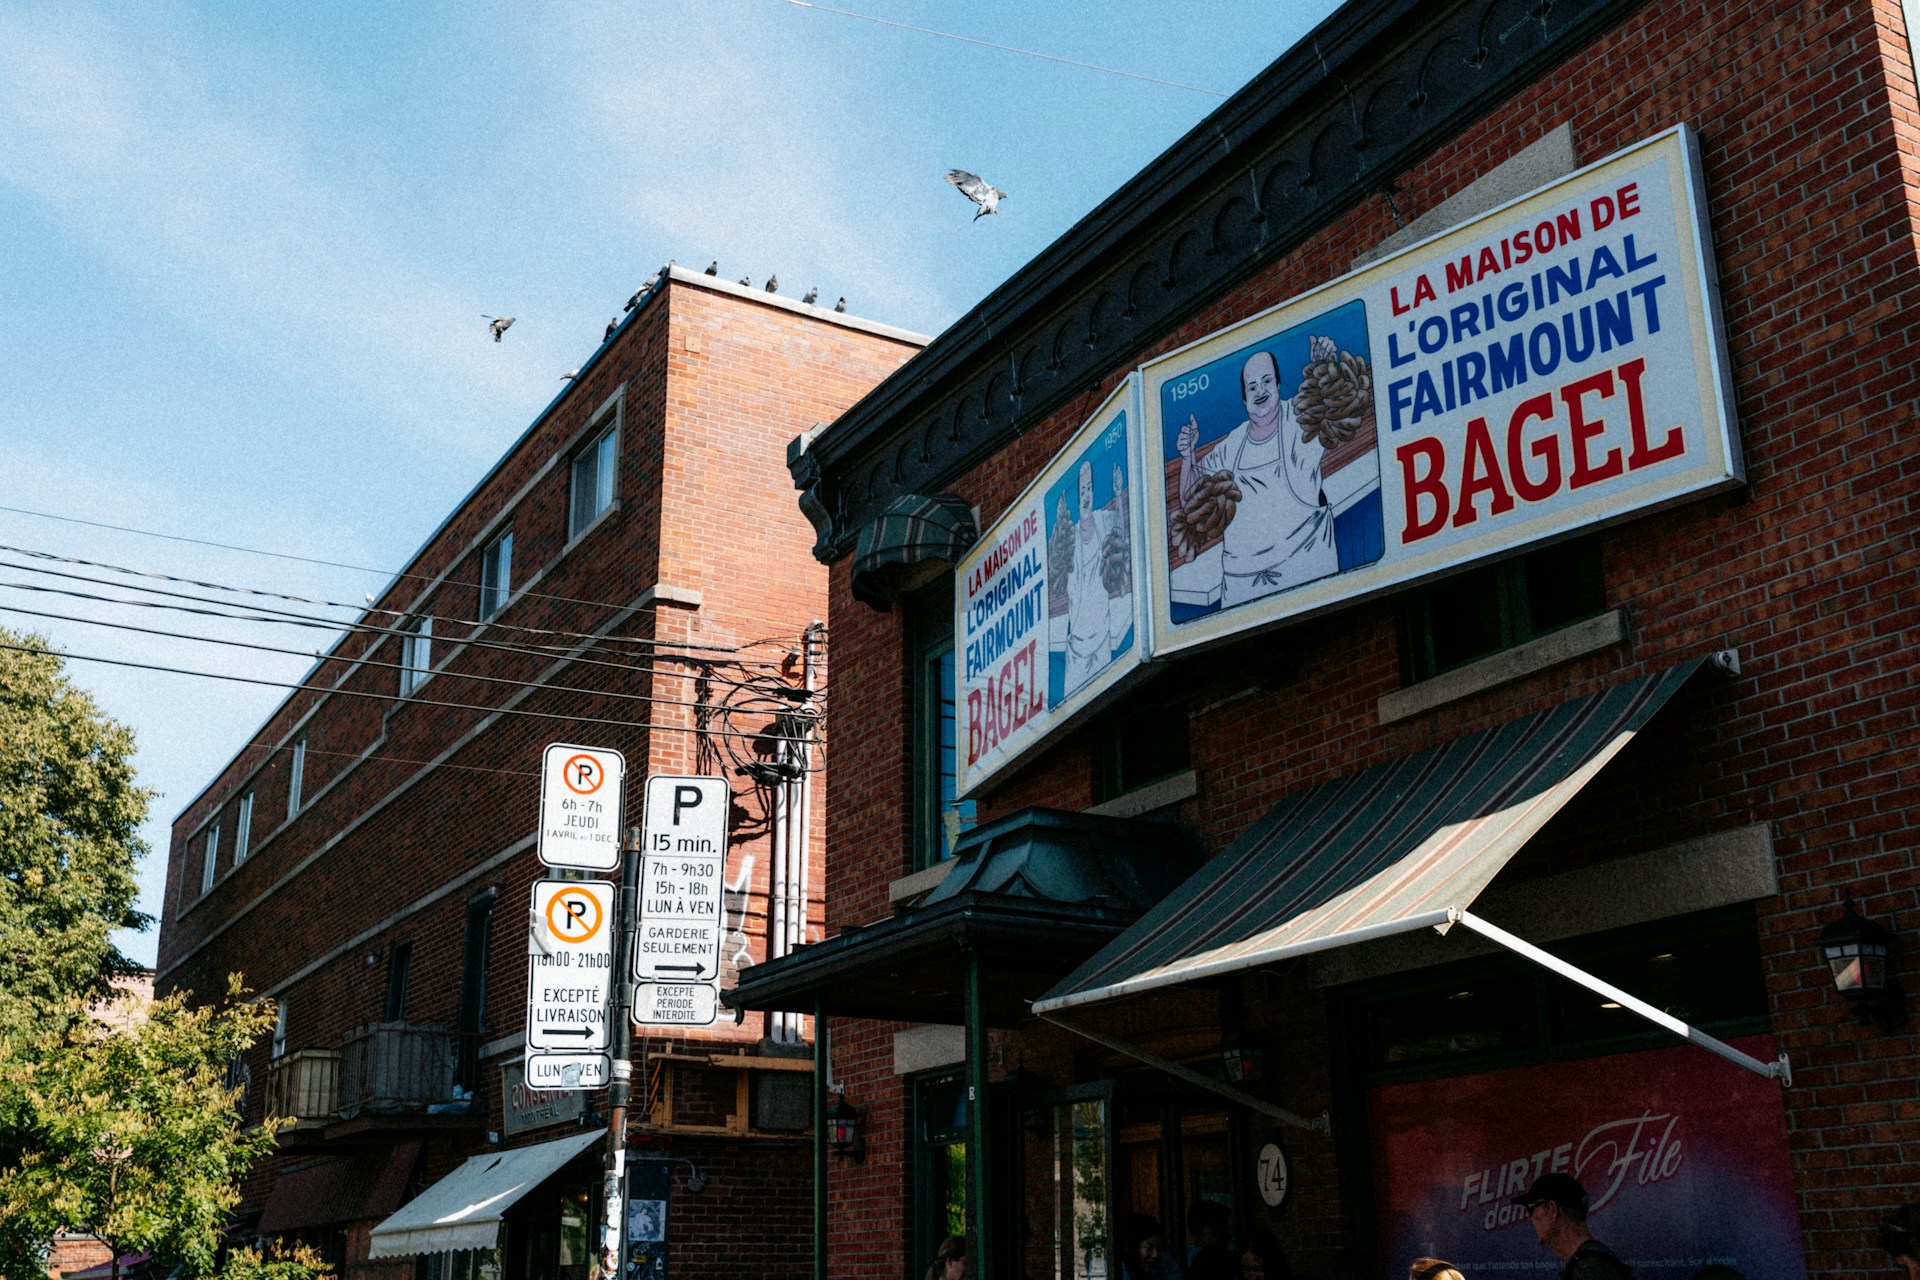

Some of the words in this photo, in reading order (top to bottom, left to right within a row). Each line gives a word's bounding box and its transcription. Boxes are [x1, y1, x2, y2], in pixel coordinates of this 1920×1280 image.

[1390, 274, 1437, 317] LA
[1445, 209, 1582, 293] MAISON
[1590, 182, 1641, 232] DE
[1388, 234, 1658, 368] L'ORIGINAL
[1388, 275, 1666, 432] FAIRMOUNT
[1171, 374, 1210, 402] 1950
[1105, 421, 1123, 451] 1950
[1396, 356, 1686, 545] BAGEL
[968, 568, 982, 598] LA
[984, 525, 1022, 584] MAISON
[1023, 509, 1038, 543] DE
[967, 547, 1042, 636] L'ORIGINAL
[966, 579, 1044, 683] FAIRMOUNT
[967, 638, 1044, 768] BAGEL
[562, 798, 577, 811] 6h
[588, 800, 603, 813] 7h
[673, 785, 703, 826] P
[563, 815, 599, 829] JEUDI
[552, 830, 578, 840] AVRIL
[653, 834, 671, 851] 15
[677, 835, 717, 853] min.
[652, 862, 668, 875] 7h
[681, 863, 714, 878] 9h30
[655, 881, 675, 894] 15h
[688, 882, 708, 896] 18h
[647, 899, 672, 913] LUN
[690, 901, 714, 914] VEN
[649, 927, 710, 940] GARDERIE
[578, 952, 611, 968] 21h00
[643, 942, 714, 955] SEULEMENT
[544, 986, 600, 1003] EXCEPTÉ
[537, 1008, 606, 1023] LIVRAISON
[653, 1009, 696, 1020] INTERDITE
[537, 1064, 560, 1077] LUN
[580, 1063, 602, 1077] VEN
[1460, 1142, 1573, 1210] FLIRTE
[1574, 1109, 1682, 1212] File
[1260, 1156, 1285, 1191] 74
[1485, 1201, 1530, 1230] dan
